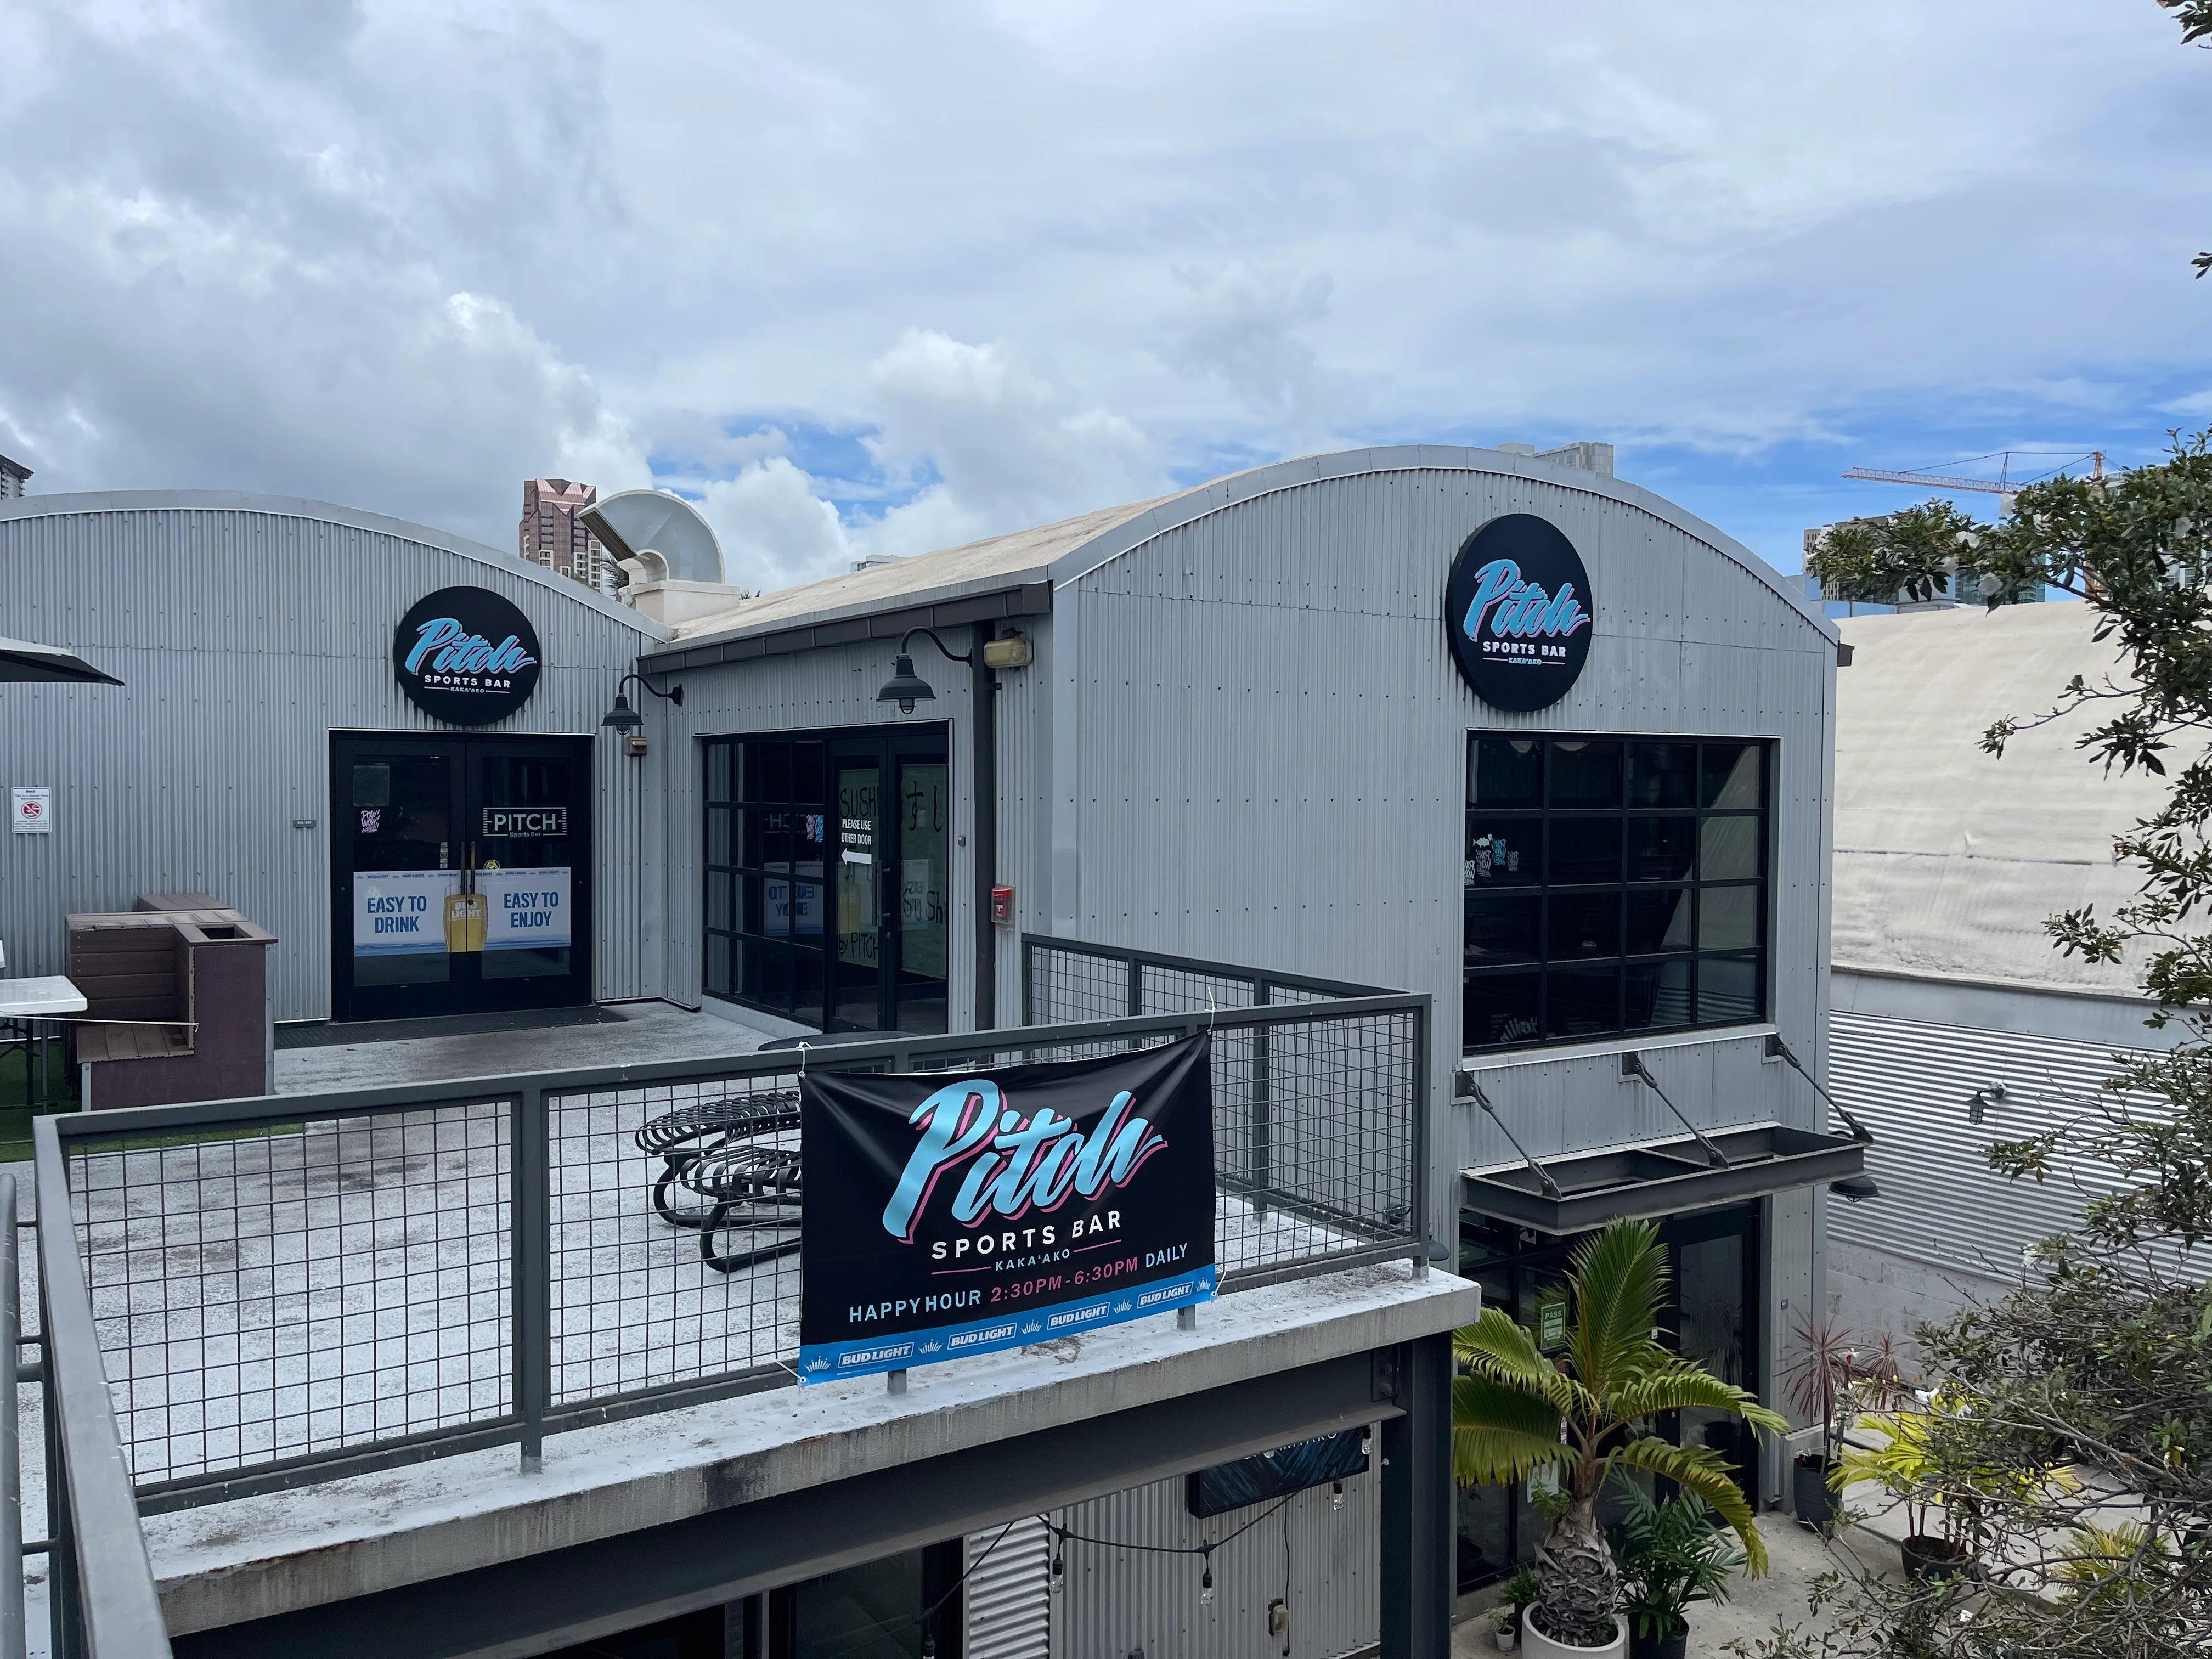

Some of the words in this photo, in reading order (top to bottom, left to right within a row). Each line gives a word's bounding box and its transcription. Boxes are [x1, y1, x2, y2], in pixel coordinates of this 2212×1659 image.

[1463, 558, 1590, 642] Pitch
[405, 617, 537, 676] Pitch
[1483, 641, 1535, 654] SPORTS
[1541, 645, 1566, 657] BAR
[424, 675, 478, 686] SPORTS
[484, 679, 511, 688] BAR
[906, 781, 943, 832] すし
[494, 814, 556, 831] PITCH
[842, 819, 860, 830] PLEASE
[861, 820, 871, 831] USE
[841, 832, 857, 844] OTHER
[857, 834, 872, 845] DOOR
[367, 896, 405, 913] EASY
[408, 896, 426, 912] TO
[455, 901, 477, 910] BUD
[504, 892, 538, 909] EASY
[541, 891, 558, 907] TO
[452, 909, 481, 919] LIGHT
[511, 911, 552, 928] ENJOY
[375, 916, 420, 933] DRINK
[882, 1079, 1168, 1244] Pitch
[932, 1226, 1056, 1259] SPORTS
[1072, 1210, 1120, 1238] BAR
[1146, 1243, 1187, 1268] DAILY
[1139, 1293, 1162, 1305] BUD
[1162, 1284, 1192, 1299] LIGHT
[1050, 1314, 1075, 1327] BUD
[1075, 1305, 1108, 1321] LIGHT
[1545, 1310, 1561, 1319] PASS
[951, 1335, 977, 1346] BUD
[979, 1325, 1014, 1341] LIGHT
[842, 1352, 871, 1365] BUD
[872, 1345, 911, 1361] LIGHT
